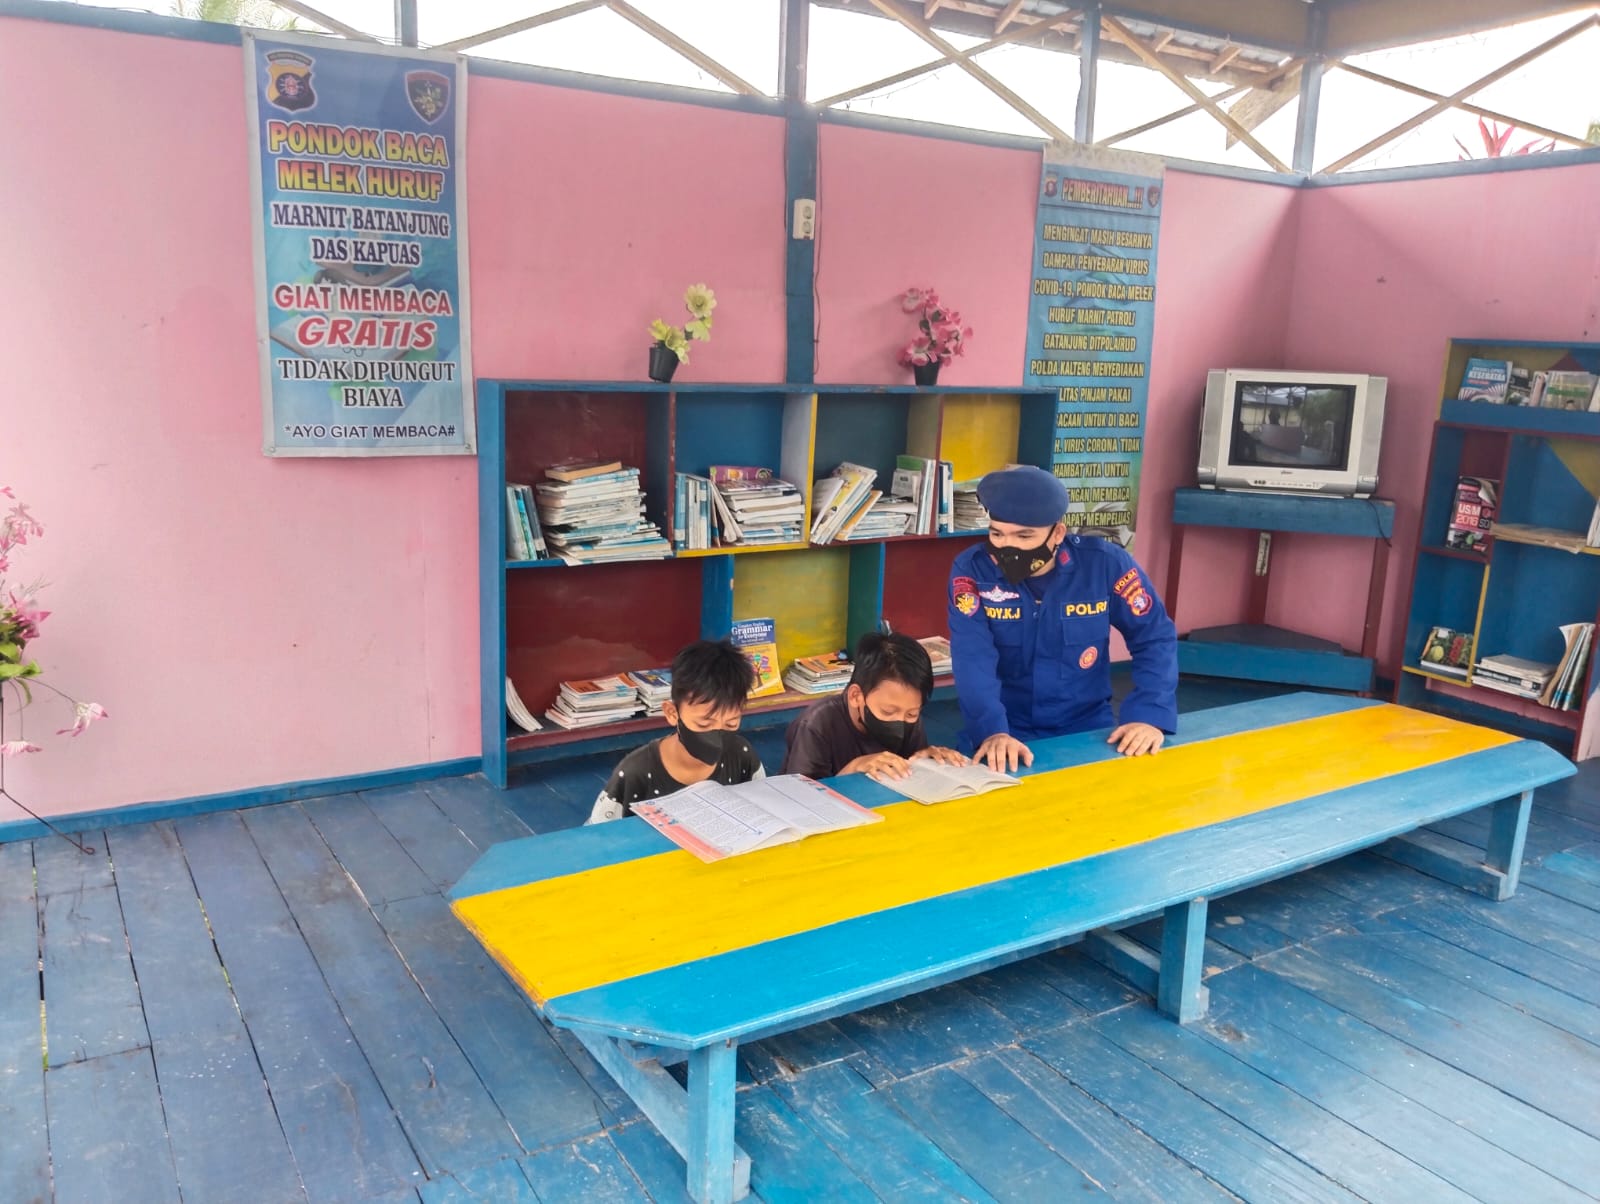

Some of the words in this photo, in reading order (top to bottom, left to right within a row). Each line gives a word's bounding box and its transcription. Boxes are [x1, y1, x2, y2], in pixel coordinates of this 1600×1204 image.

[269, 121, 381, 160] PONDOK
[385, 131, 448, 166] BACA
[278, 160, 362, 194] MELEK
[367, 166, 443, 200] HURUF
[273, 204, 346, 228] MARNIT
[353, 208, 449, 236] BATANJUNG
[1043, 224, 1088, 243] MENGINGAT
[1091, 228, 1115, 246] MASIH
[1116, 230, 1152, 249] BESARNYA
[312, 238, 347, 261] DAS
[354, 241, 420, 265] KAPUAS
[1043, 252, 1075, 271] DAMPAK
[1078, 254, 1124, 273] PENYEBARAN
[1125, 258, 1149, 276] VIRUS
[275, 285, 331, 309] GIAT
[340, 288, 451, 314] MEMBACA
[1034, 280, 1074, 298] COVID-19,
[1077, 282, 1106, 299] PONDOK
[1108, 284, 1126, 300] BACA
[1127, 285, 1153, 301] MELEK
[1048, 306, 1075, 323] HURUF
[1077, 308, 1105, 325] MARNIT
[1107, 310, 1136, 327] PATROLI
[298, 318, 435, 348] GRATIS
[1043, 333, 1088, 351] BATANJUNG
[1089, 335, 1136, 352] DITPOLAIRUD
[279, 360, 350, 380] TIDAK
[354, 362, 455, 381] DIPUNGUT
[1030, 359, 1058, 376] POLDA
[1060, 360, 1090, 376] KALTENG
[1092, 361, 1145, 378] MENYEDIAKAN
[344, 388, 403, 407] BIAYA
[1080, 387, 1107, 403] PINJAM
[1108, 387, 1131, 403] PAKAI
[1057, 413, 1081, 428] ACAAN
[1083, 412, 1106, 428] UNTUK
[1108, 412, 1117, 428] DI
[331, 426, 368, 438] GIAT
[373, 425, 455, 438] MEMBACA#
[1063, 437, 1084, 453] VIRUS
[1087, 437, 1118, 453] CORONA
[1120, 437, 1141, 453] TIDAK
[1085, 462, 1102, 478] KITA
[1104, 462, 1130, 478] UNTUK
[1092, 487, 1130, 502] MEMBACA
[1086, 511, 1131, 526] MEMPELUAS
[1066, 601, 1107, 616] POLRI
[731, 625, 773, 635] Grammar
